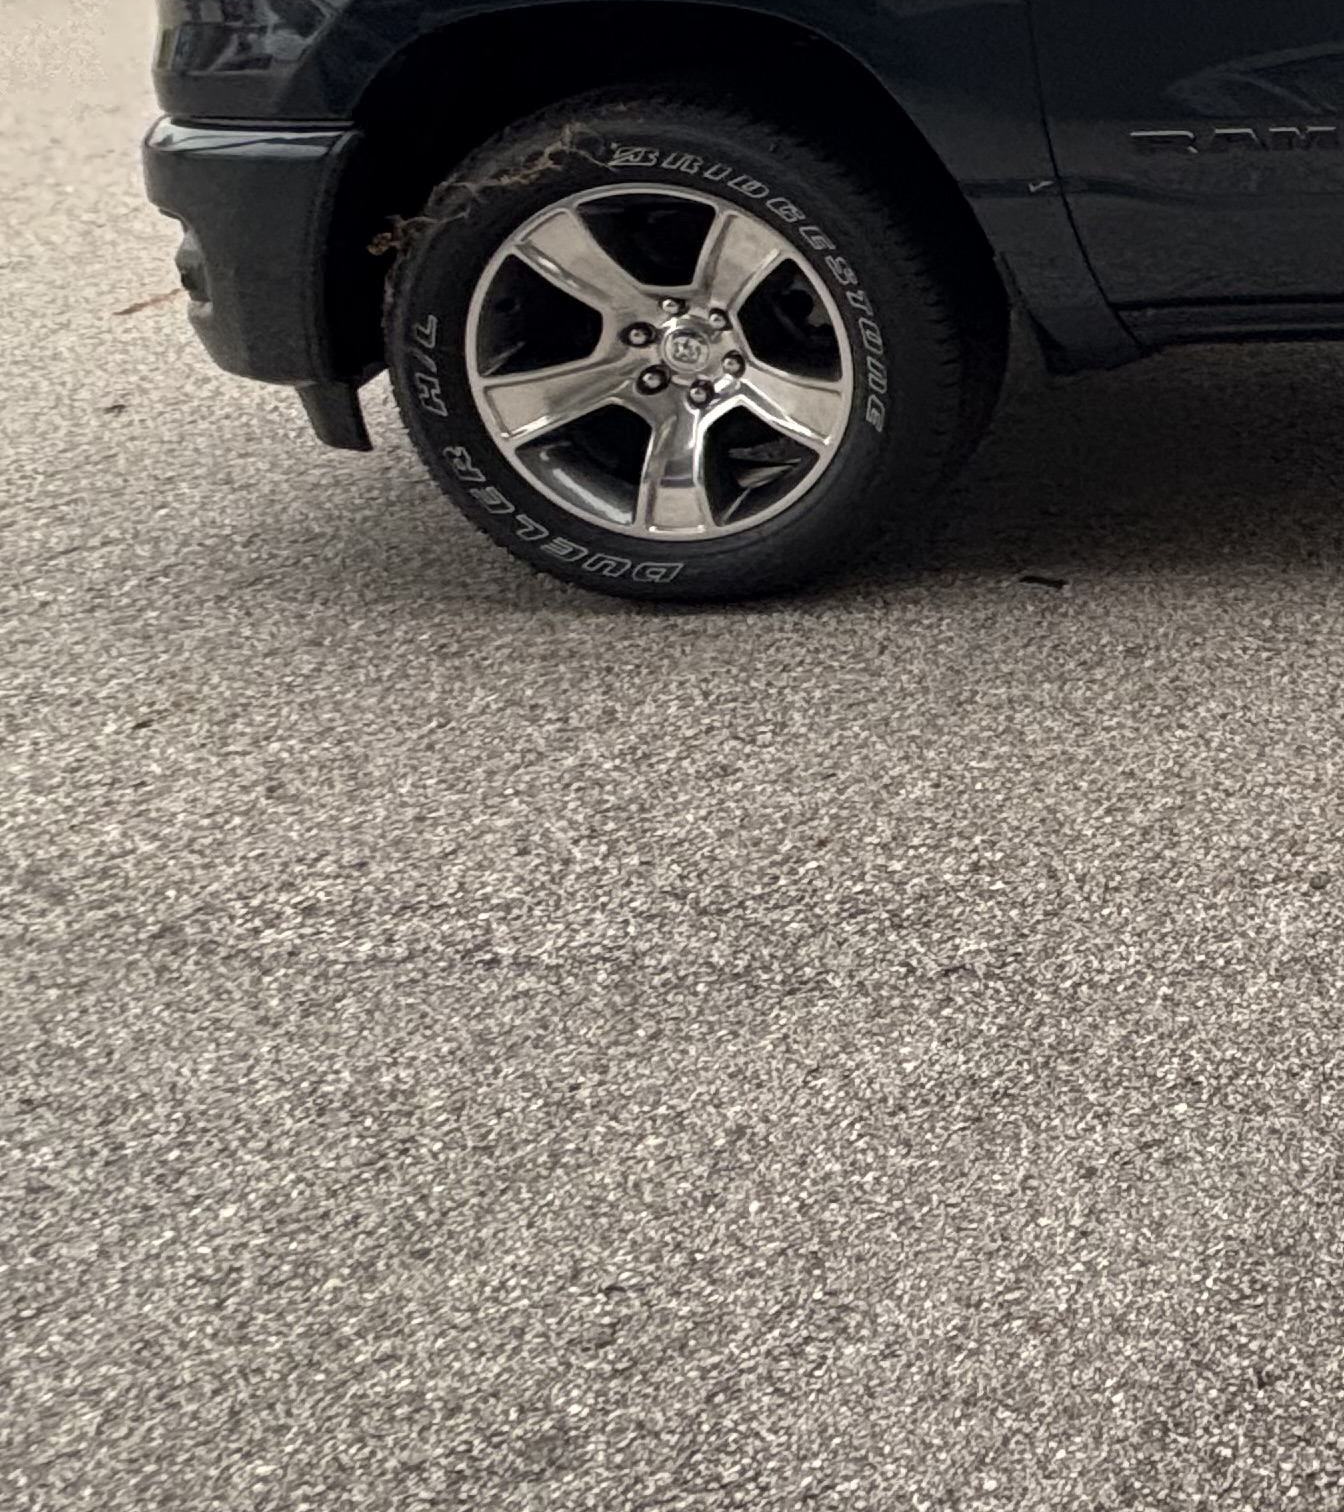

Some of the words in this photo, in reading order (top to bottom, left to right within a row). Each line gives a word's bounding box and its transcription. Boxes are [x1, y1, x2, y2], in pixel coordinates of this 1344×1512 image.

[1129, 125, 1342, 154] RAM
[608, 143, 888, 433] BRIDGESTONE
[443, 445, 684, 585] DUELER
